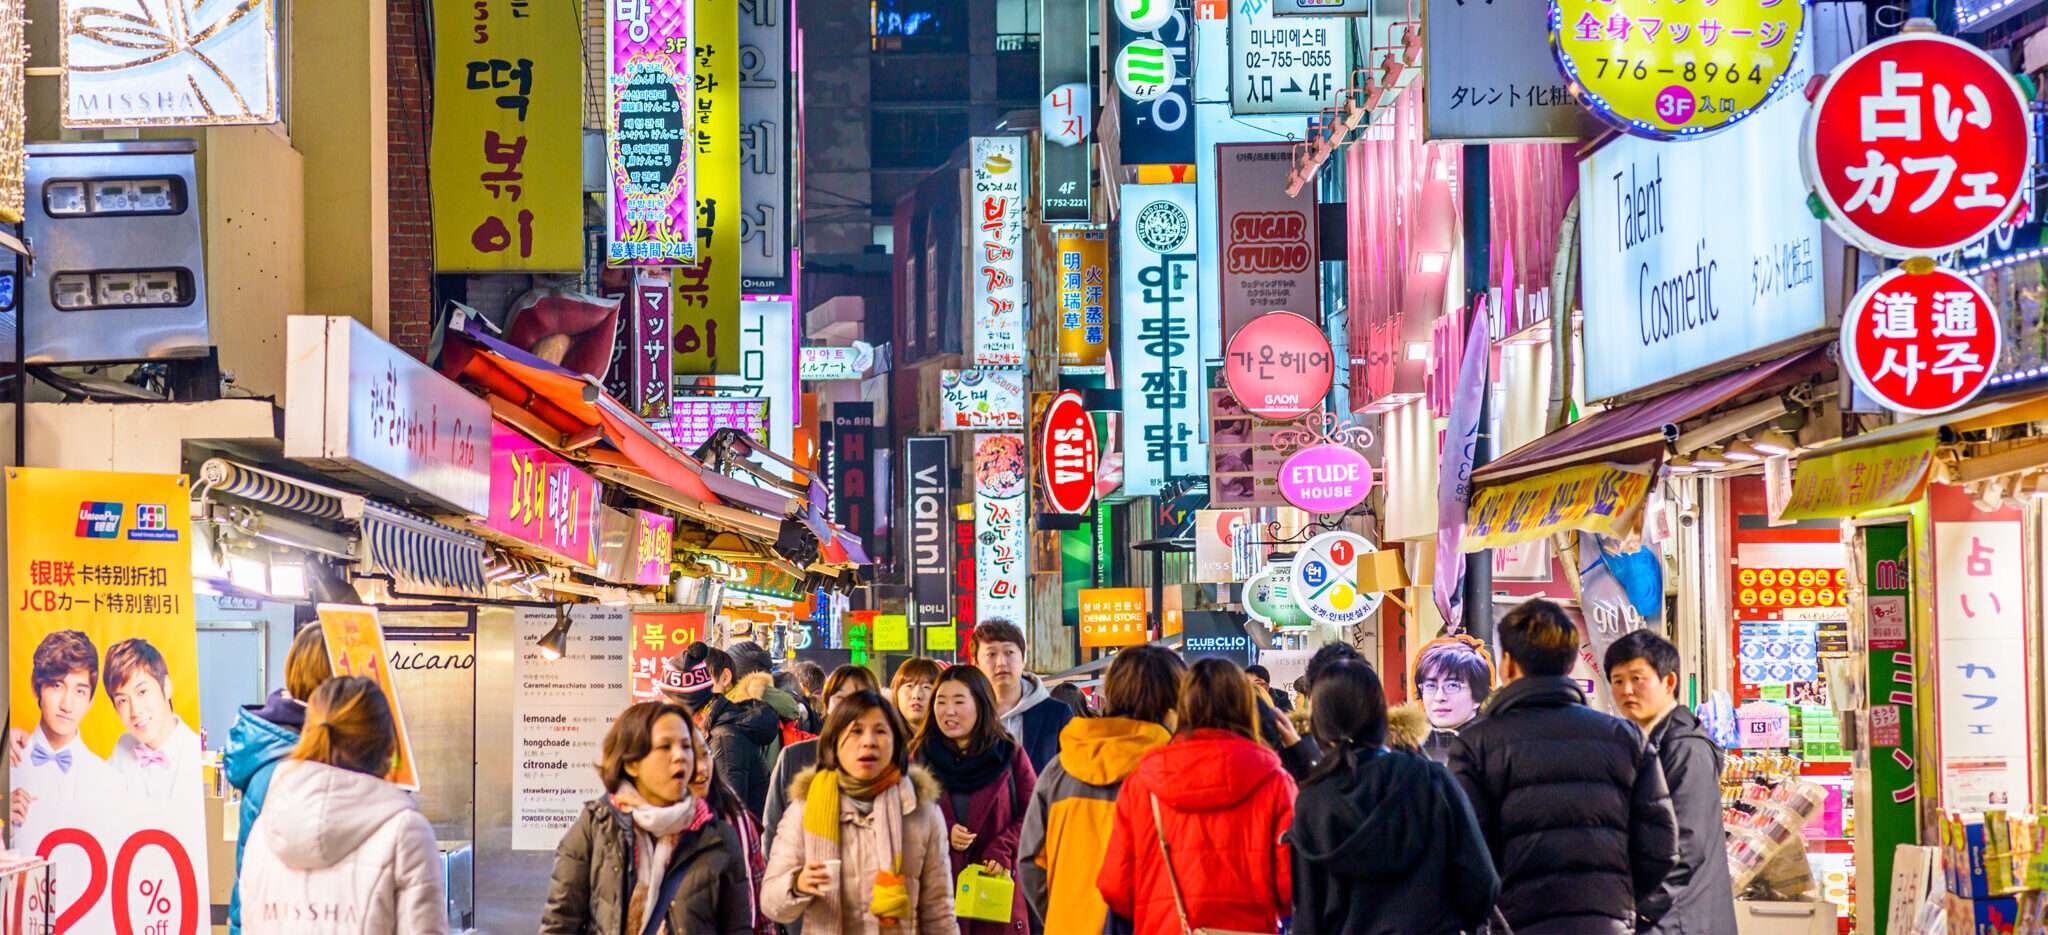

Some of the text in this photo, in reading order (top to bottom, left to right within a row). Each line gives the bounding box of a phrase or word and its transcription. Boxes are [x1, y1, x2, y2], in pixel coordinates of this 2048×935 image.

[1250, 28, 1327, 48] 미나미에스테
[1576, 11, 1788, 47] 全身マッサージ
[665, 37, 688, 54] 3F
[1246, 50, 1332, 69] 02-755-0555
[1596, 57, 1762, 85] 776-8964
[1136, 85, 1158, 95] 4F
[1247, 72, 1332, 103] 入口 4F
[1450, 84, 1578, 110] タレント化粧
[1859, 60, 1992, 142] 占い
[77, 91, 196, 114] MISSHA
[1051, 88, 1083, 144] 니지
[1658, 93, 1736, 117] 3F 入口
[466, 58, 534, 258] 떡볶이
[1059, 181, 1077, 194] 4F
[1843, 149, 2007, 214] カフェ
[1613, 152, 1665, 252] Talent
[1235, 217, 1302, 240] SUGAR
[666, 243, 693, 257] 24時
[981, 196, 1014, 317] 부대찌개
[1231, 246, 1308, 269] STUDIO
[1063, 252, 1082, 329] 明洞瑞草
[1639, 237, 1719, 346] Cosmetic
[1086, 266, 1104, 344] 火汗蒸幕
[1872, 291, 1977, 339] 道通
[643, 291, 665, 403] マッサージ
[1137, 264, 1193, 462] 안동찜닭
[1231, 345, 1329, 379] 가온헤어
[1872, 346, 1984, 396] 사주
[1264, 394, 1299, 404] GAON
[1292, 463, 1360, 484] ETUDE
[1301, 486, 1352, 499] HOUSE
[914, 464, 945, 574] vianni
[30, 559, 167, 588] 银联卡特别折扣
[1960, 536, 2001, 618] 占い
[21, 589, 179, 615] JCBカード特別割引
[1114, 613, 1142, 622] STORE
[523, 714, 567, 723] lemonade
[523, 738, 570, 748] hongchoade
[523, 760, 568, 769] citronade
